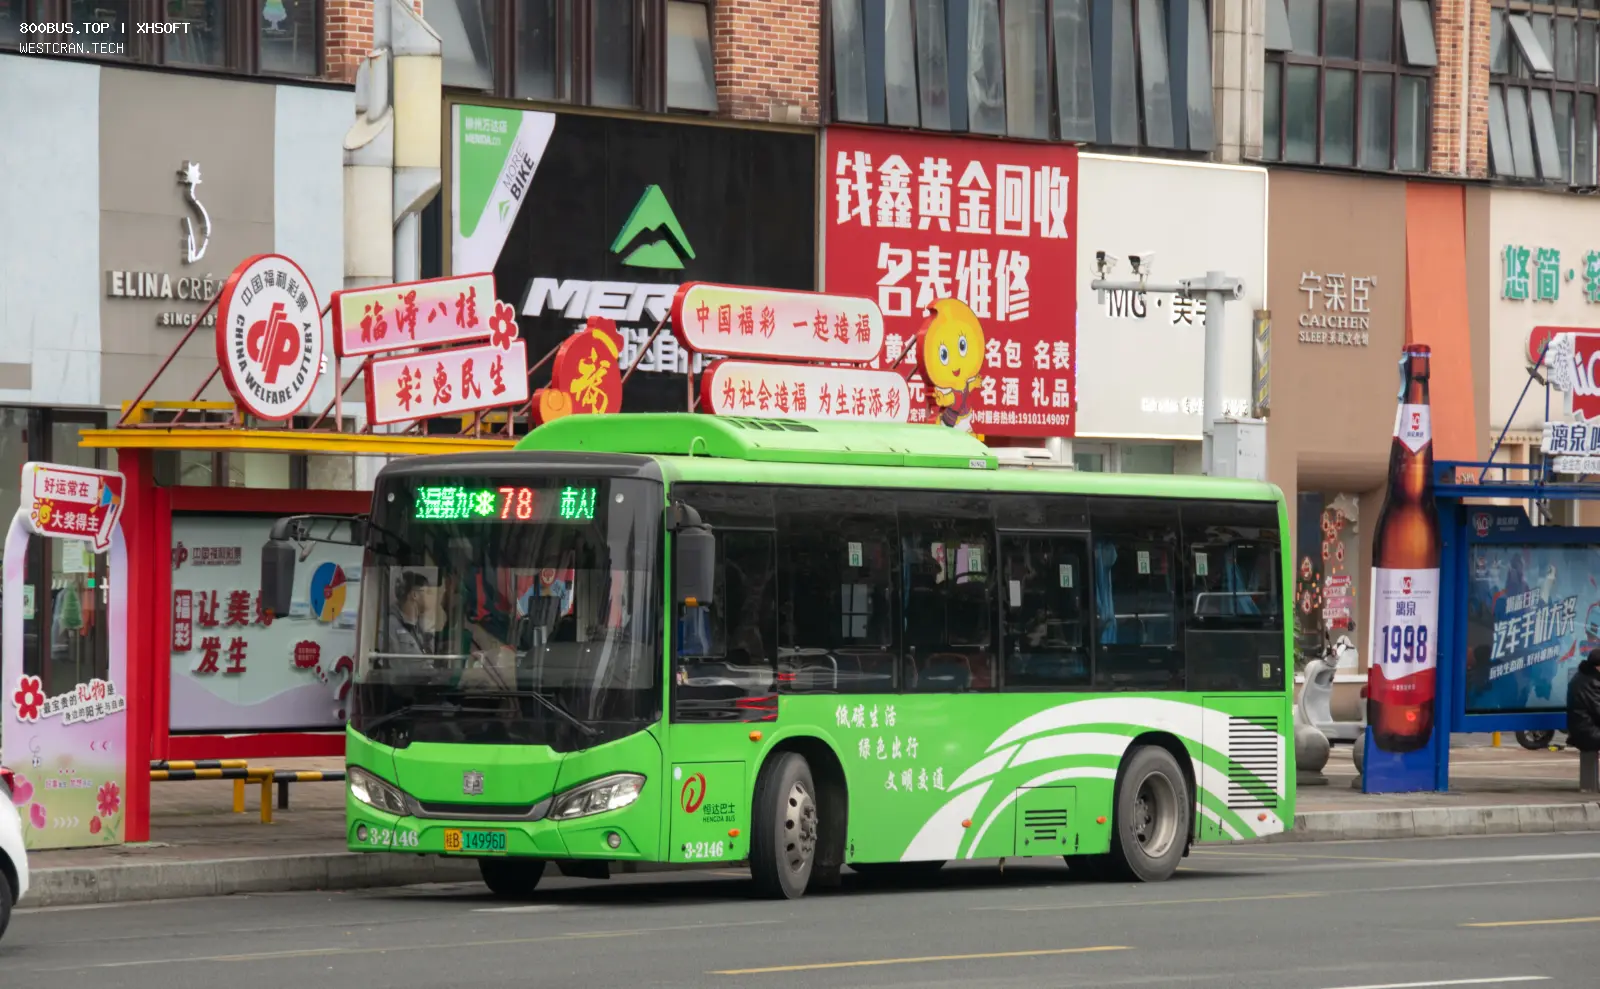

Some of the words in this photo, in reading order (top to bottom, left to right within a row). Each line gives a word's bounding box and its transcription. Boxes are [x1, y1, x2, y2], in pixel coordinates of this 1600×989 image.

[502, 141, 526, 190] MORE
[510, 153, 535, 201] BIKE
[836, 151, 1069, 239] 钱鑫黄金回收
[112, 271, 173, 298] ELINA
[241, 269, 309, 313] 中国福利彩票
[876, 243, 1030, 322] 名表维修
[1299, 271, 1370, 313] 宁采臣
[521, 277, 682, 322] MER
[695, 300, 776, 339] 中国福彩
[792, 309, 872, 344] 一起造福
[1299, 314, 1369, 330] CAICHEN
[1299, 331, 1327, 343] SLEEP
[235, 314, 248, 372] CHINA
[244, 371, 292, 405] WELFARE
[292, 321, 313, 393] LOTTERY
[985, 338, 1022, 369] 名包
[1034, 340, 1070, 370] 名表
[396, 354, 507, 412] 彩惠民生
[721, 376, 807, 412] 为社会造福
[818, 382, 901, 418] 为生活添彩
[980, 375, 1019, 407] 名酒
[1032, 378, 1070, 408] 礼品
[44, 477, 89, 498] 好运常在
[500, 488, 532, 519] 78
[51, 511, 99, 532] 大奖得主
[192, 637, 247, 673] 发生
[1382, 625, 1427, 664] 1998
[835, 704, 897, 729] 低碳生活
[858, 735, 919, 760] 绿色出行
[884, 766, 945, 792] 文明交通
[703, 803, 735, 815] 恒达巴士
[370, 828, 419, 847] 3-2146
[684, 841, 724, 859] 3-2146
